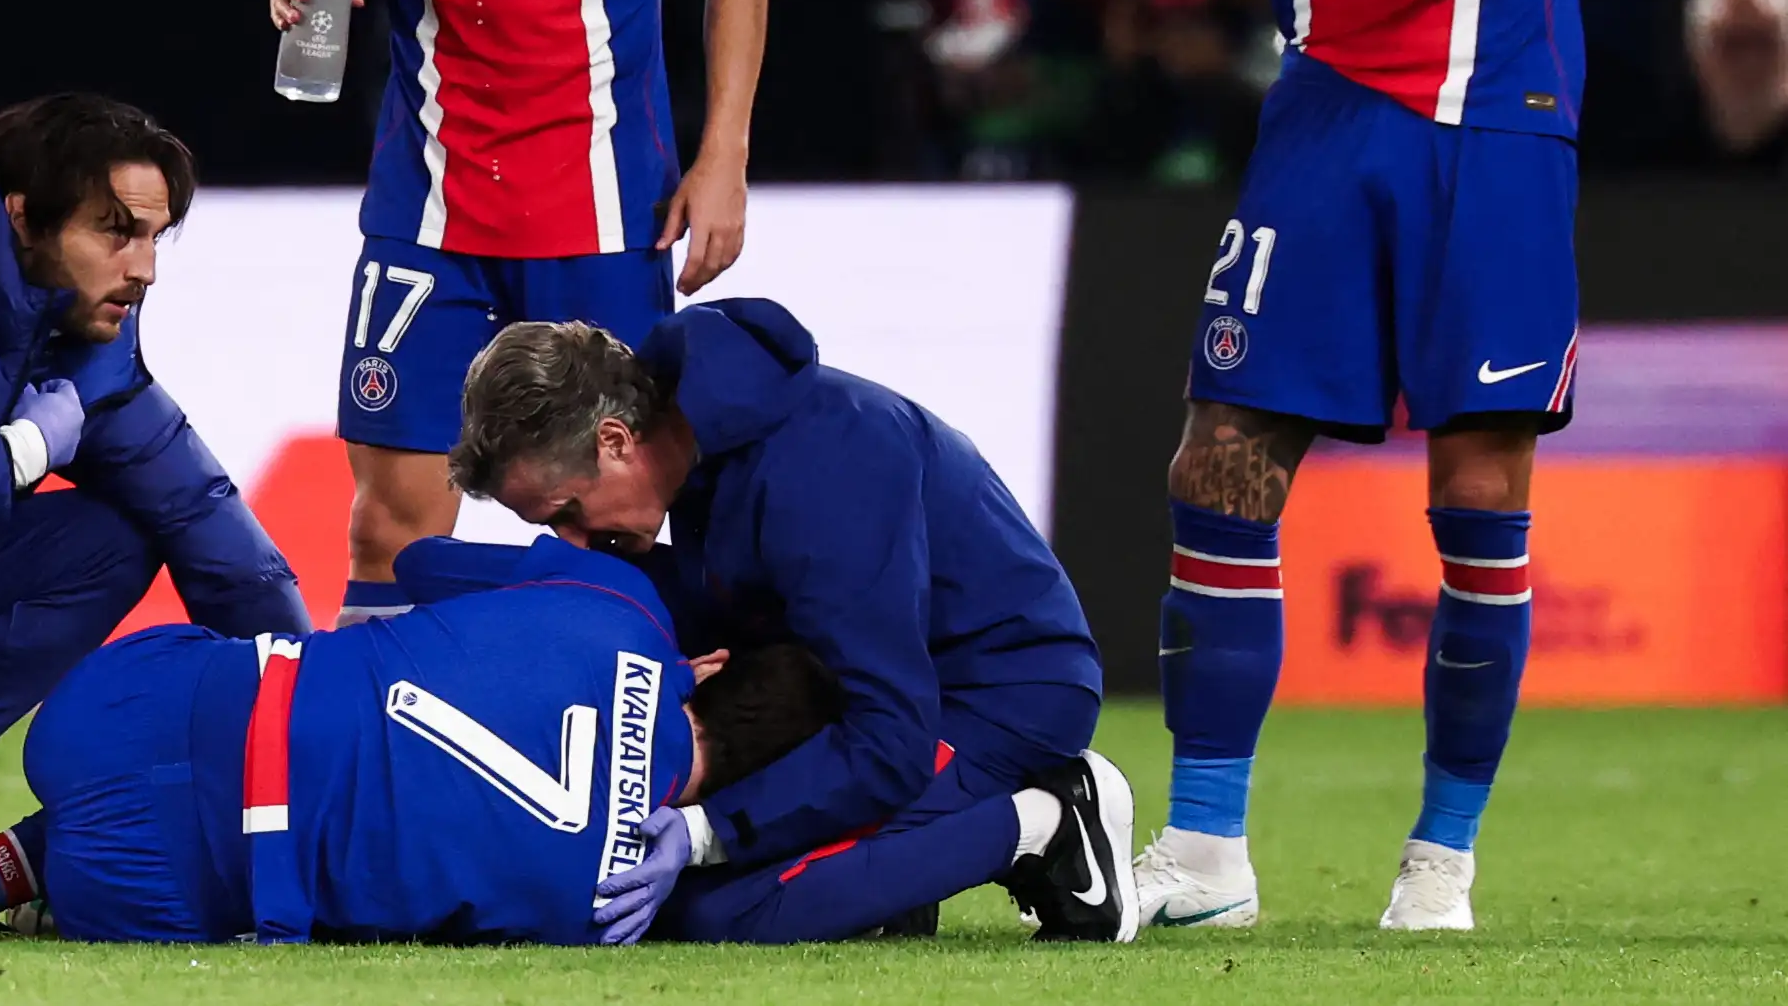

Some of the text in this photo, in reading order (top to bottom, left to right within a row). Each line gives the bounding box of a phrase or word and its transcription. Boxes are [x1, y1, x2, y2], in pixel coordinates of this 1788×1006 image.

[354, 260, 435, 353] 17
[1204, 218, 1277, 315] 21
[359, 359, 390, 375] PARIS
[386, 680, 598, 835] 7
[607, 661, 654, 879] KVARATSKHEL
